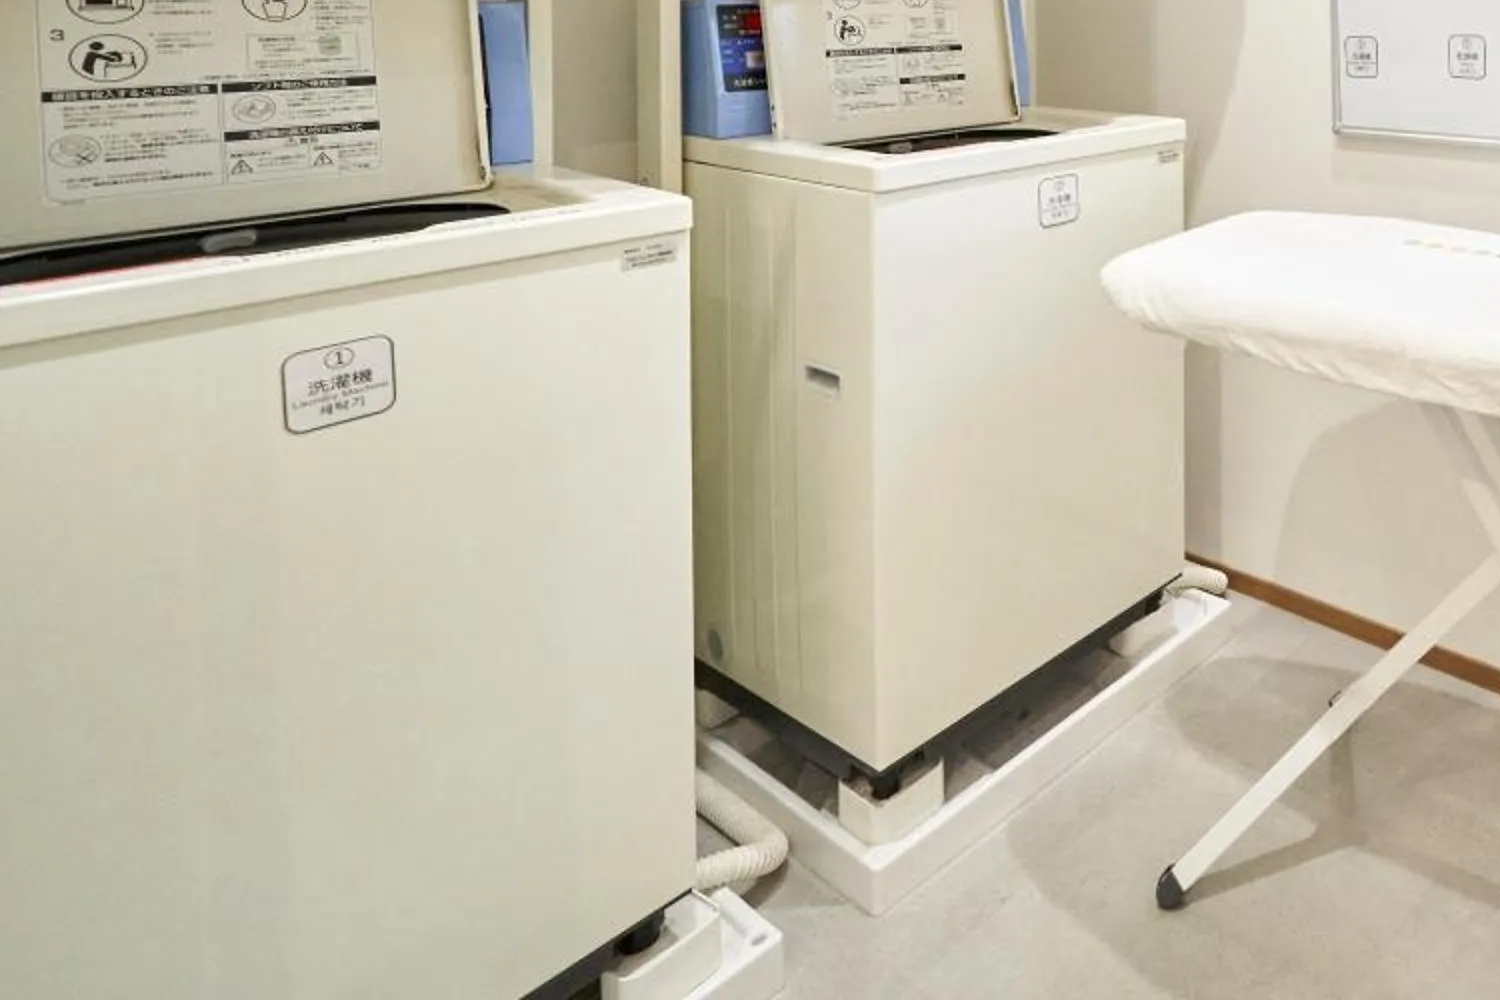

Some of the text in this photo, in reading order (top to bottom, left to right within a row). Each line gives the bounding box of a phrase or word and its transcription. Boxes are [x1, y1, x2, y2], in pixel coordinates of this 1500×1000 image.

[50, 29, 65, 41] 3
[308, 368, 372, 396] 洗濯機
